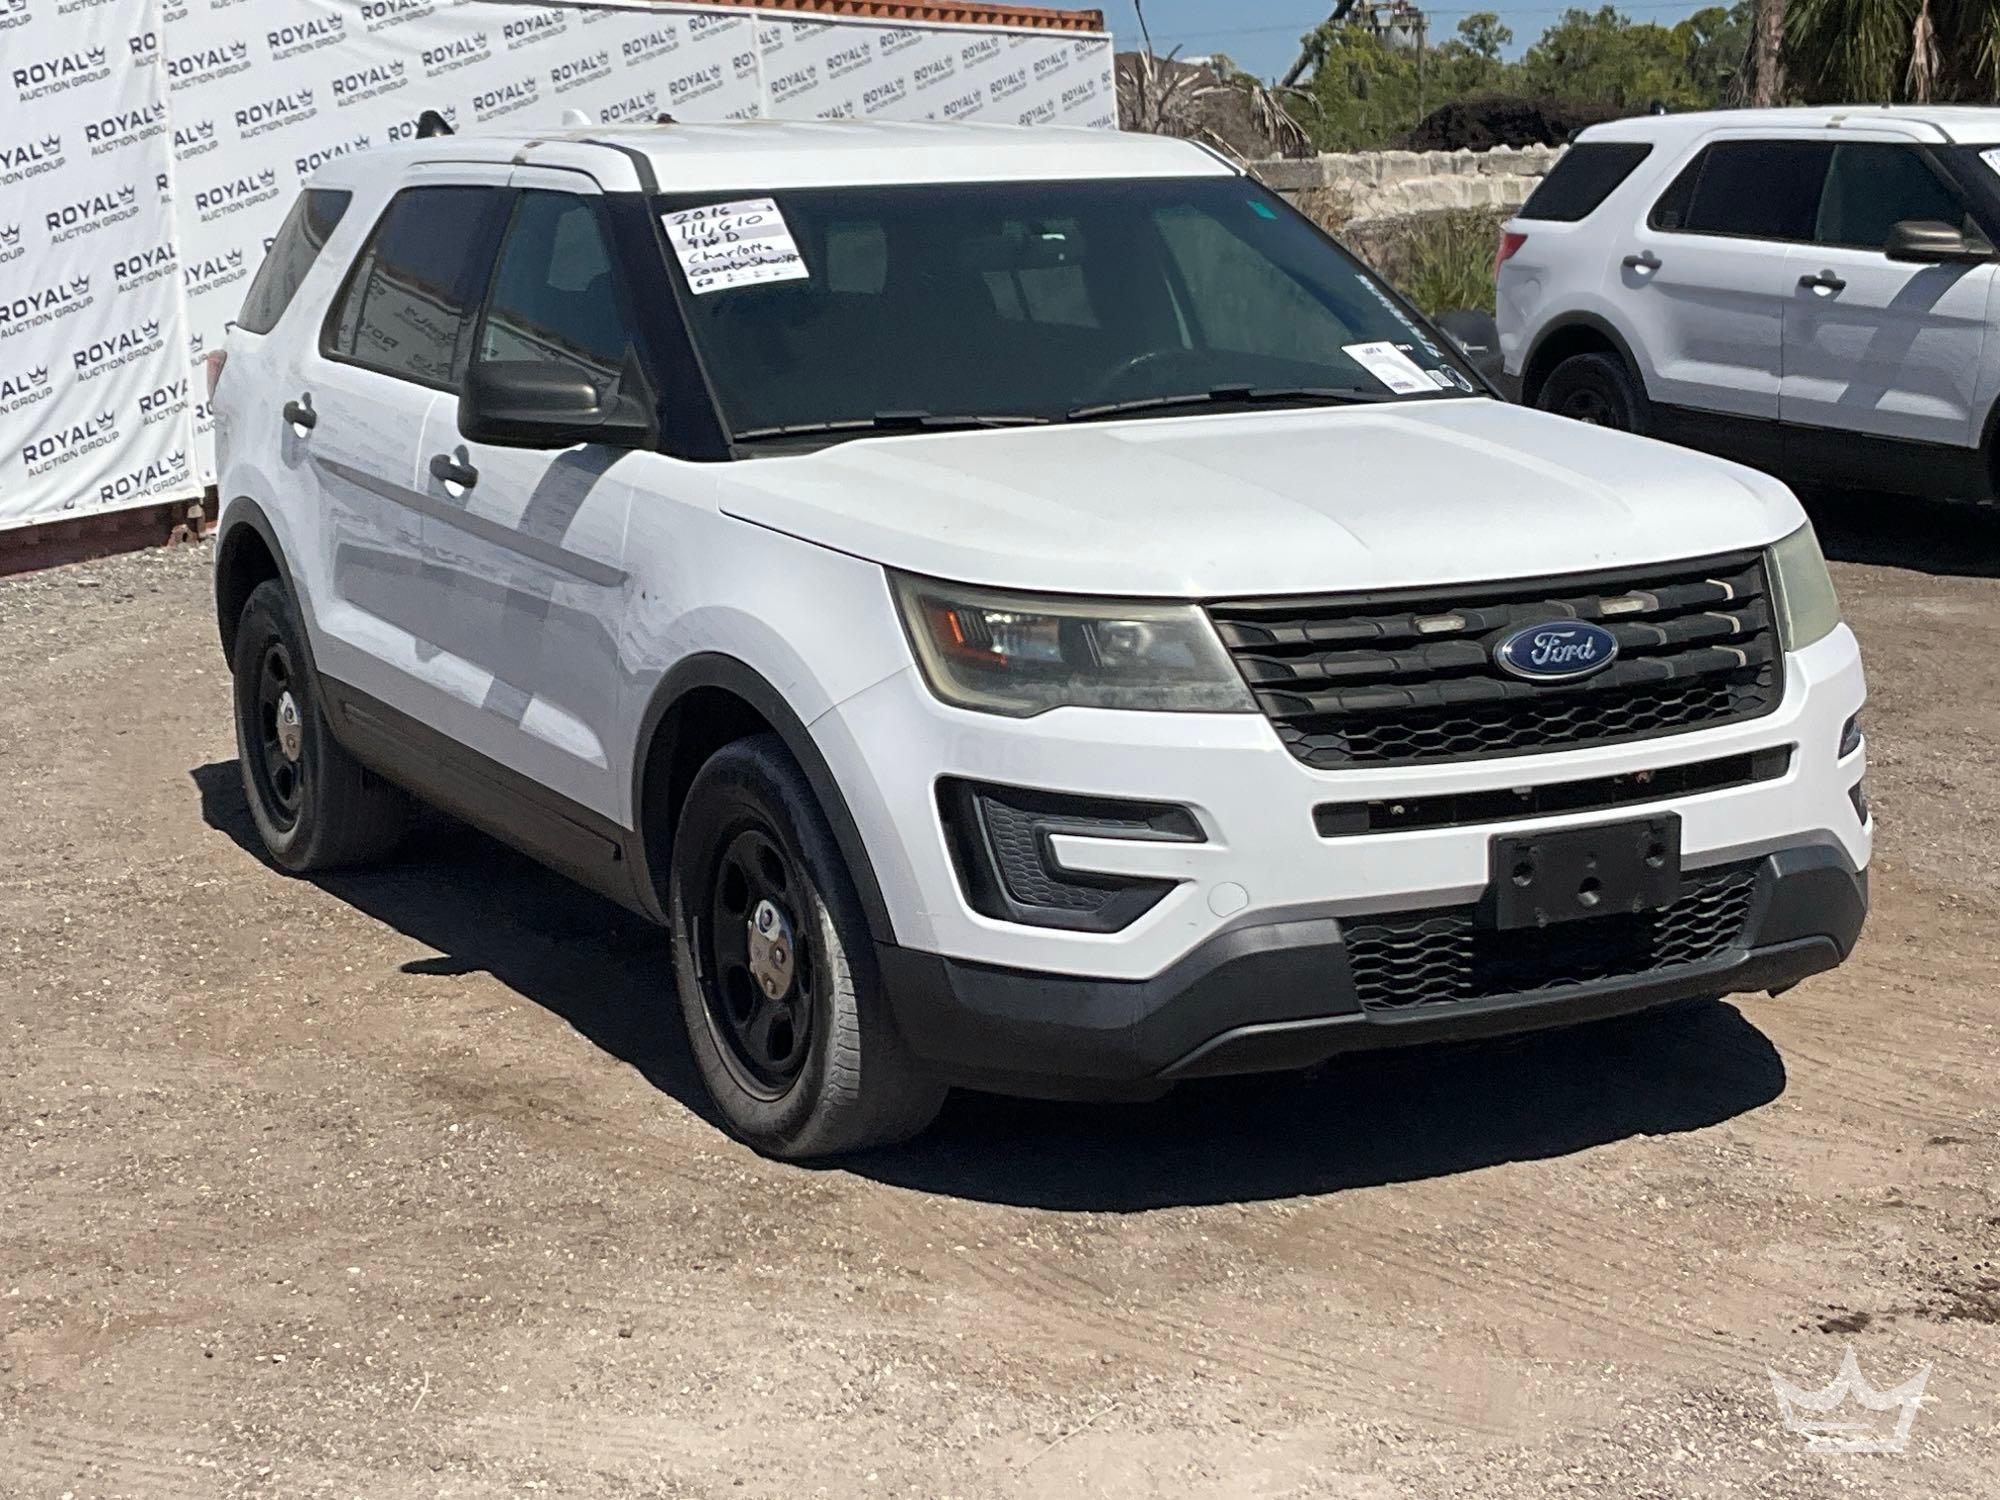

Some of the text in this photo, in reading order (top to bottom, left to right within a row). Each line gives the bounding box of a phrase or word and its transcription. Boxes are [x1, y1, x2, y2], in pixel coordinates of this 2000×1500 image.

[267, 19, 328, 49] ROYAL
[503, 13, 553, 40] ROYAL
[421, 38, 475, 67] ROYAL
[622, 30, 666, 57] ROYAL
[13, 54, 89, 88] ROYAL
[167, 48, 232, 78] ROYAL
[550, 56, 598, 83] ROYAL
[19, 68, 111, 102] AUCTION GROUP
[332, 65, 391, 97] ROYAL
[668, 69, 710, 96] ROYAL
[235, 95, 299, 127] ROYAL
[473, 83, 525, 112] ROYAL
[600, 95, 645, 124] ROYAL
[85, 108, 154, 142] ROYAL
[91, 135, 138, 156] AUCTION
[139, 124, 167, 140] GROU
[0, 144, 43, 169] YAL
[25, 157, 66, 178] GROUP
[195, 176, 260, 211] ROYAL
[46, 193, 119, 231] ROYAL
[51, 206, 139, 245] AUCTION GROUP
[201, 200, 244, 223] AUCTION
[672, 206, 731, 225] 2016
[114, 243, 177, 280] ROYAL
[0, 285, 72, 322] ROYAL
[0, 296, 94, 339] AUCTION GROUP
[73, 329, 143, 370] ROYAL
[77, 357, 126, 382] AUCTION
[11, 386, 53, 410] GROUP
[22, 421, 98, 465] ROYAL
[28, 431, 120, 478] AUCTION GROUP
[100, 461, 169, 503] ROYAL
[1531, 631, 1595, 665] Ford
